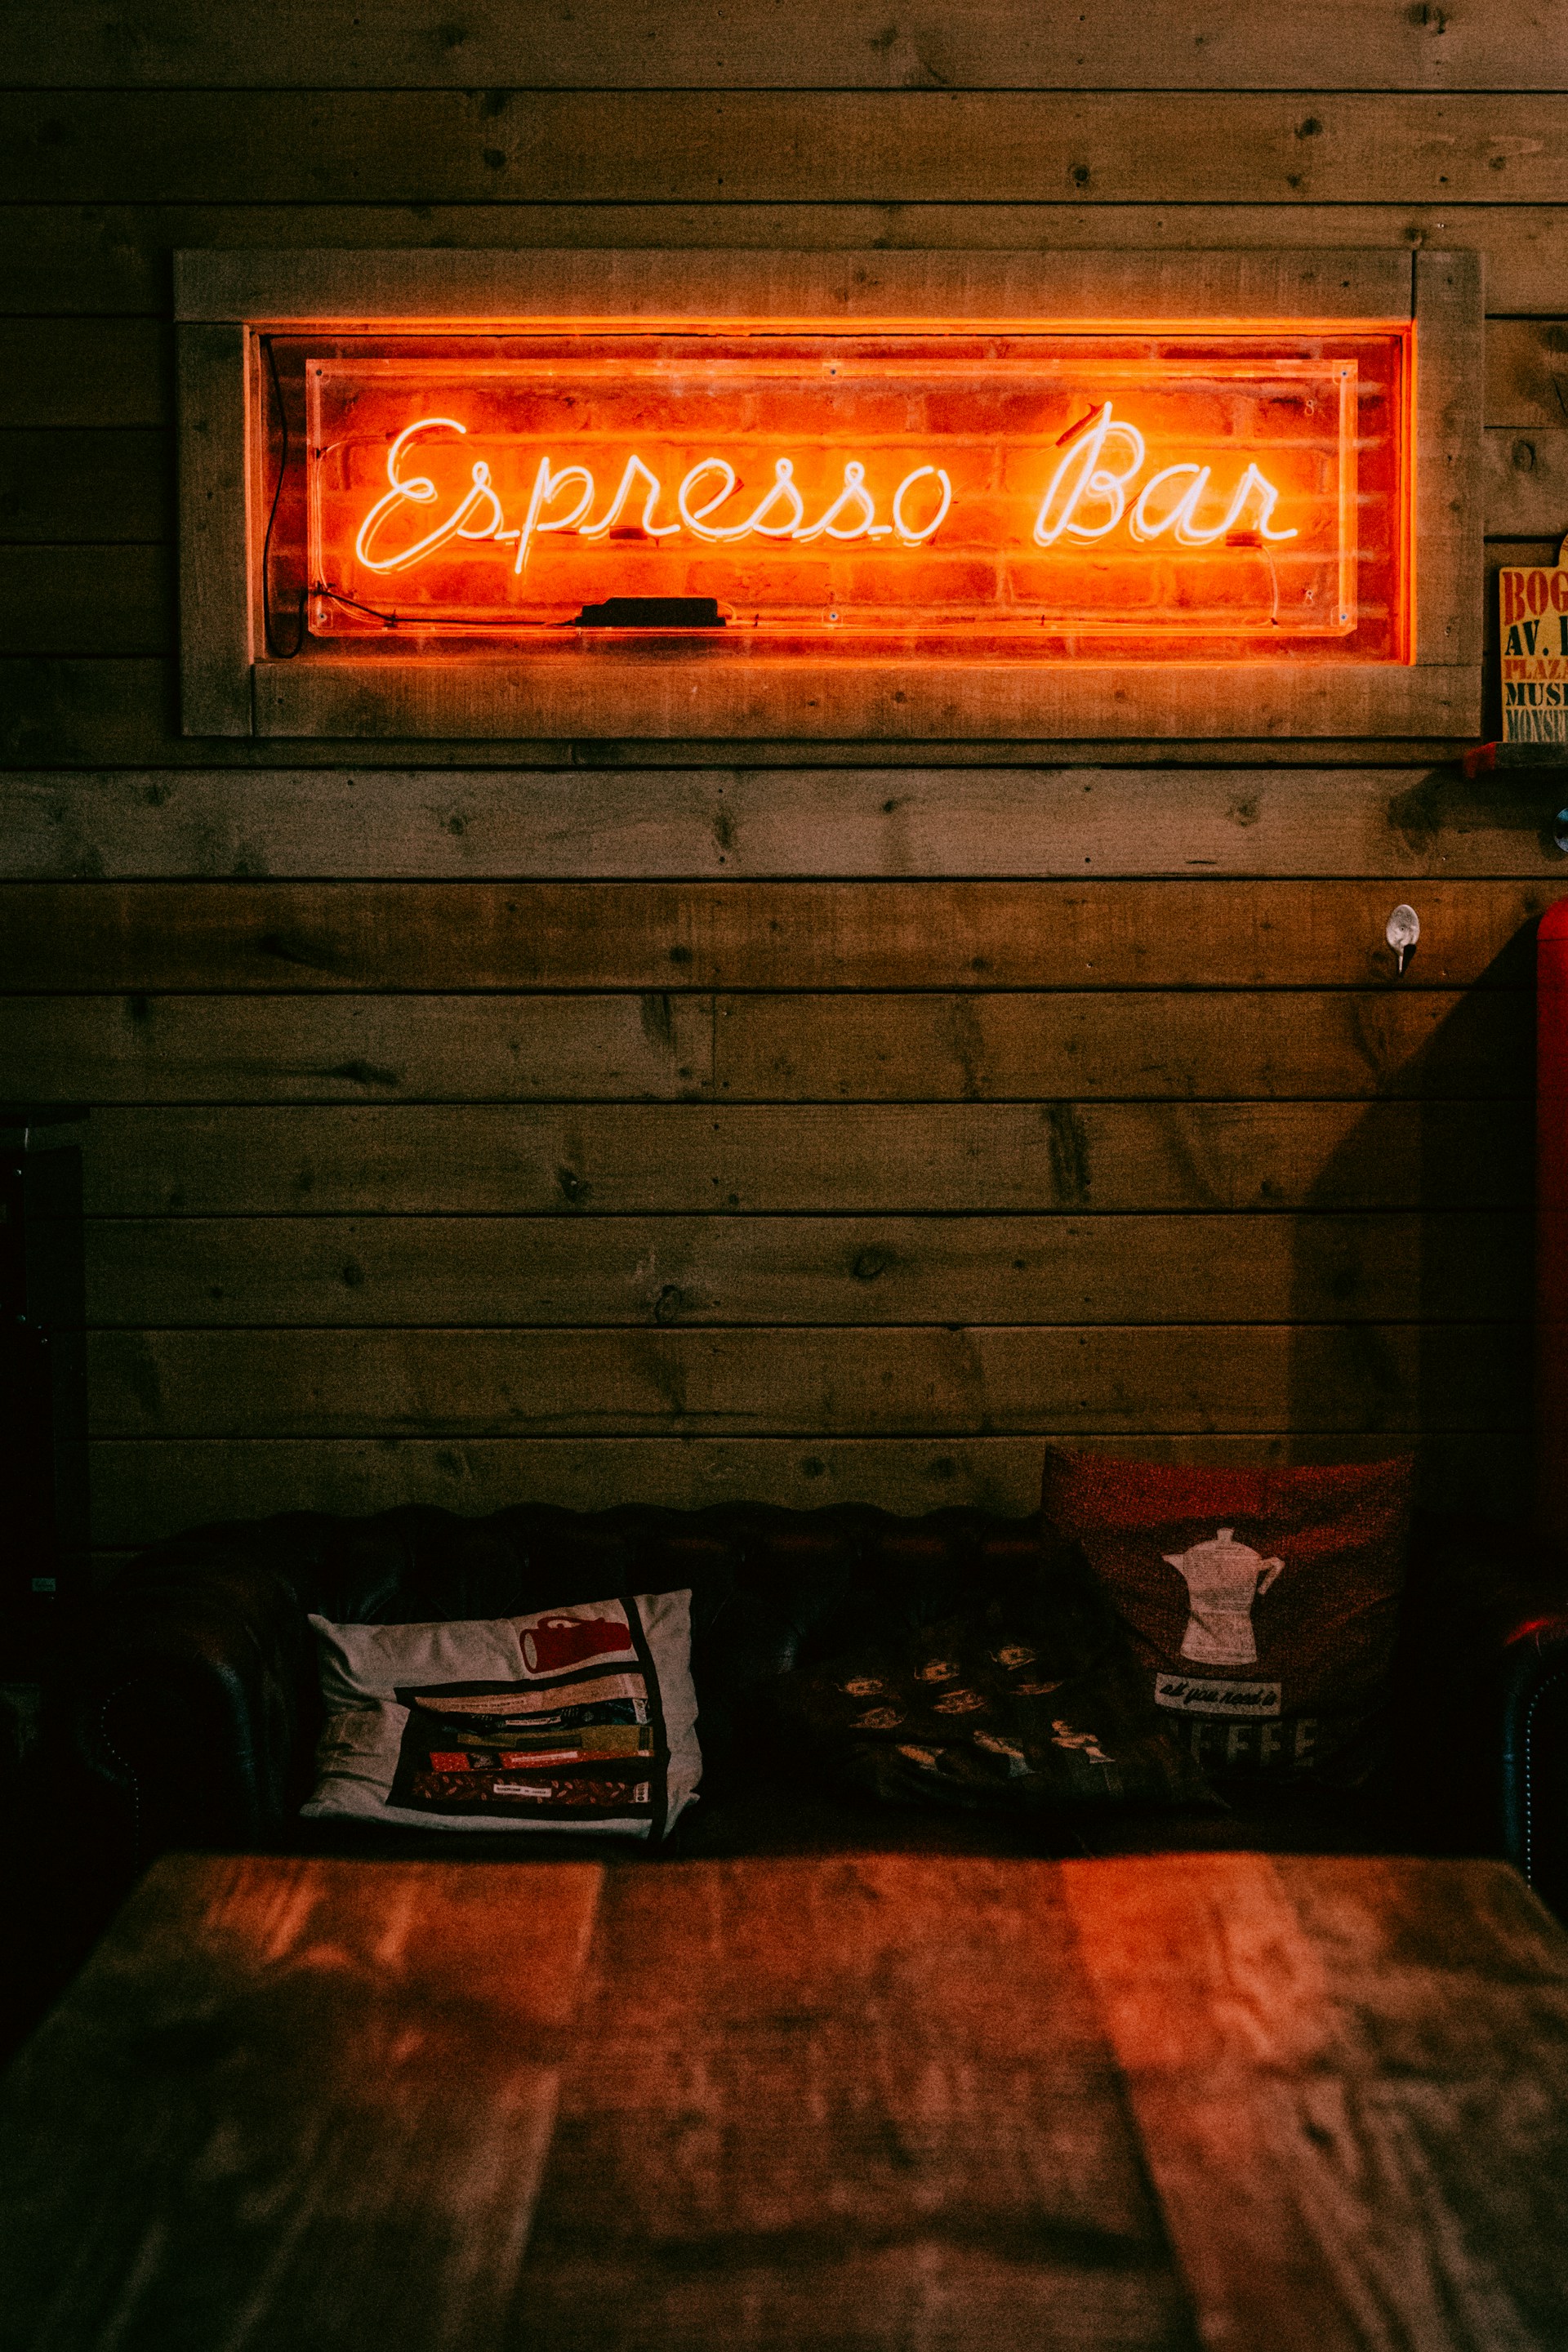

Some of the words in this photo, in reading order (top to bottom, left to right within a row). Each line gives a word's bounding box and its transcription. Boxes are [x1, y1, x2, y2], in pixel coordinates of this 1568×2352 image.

[356, 417, 953, 575] Espresso
[1034, 401, 1298, 543] Bar
[1504, 620, 1549, 656] AV.
[1184, 1688, 1218, 1704] you
[1219, 1689, 1263, 1705] need
